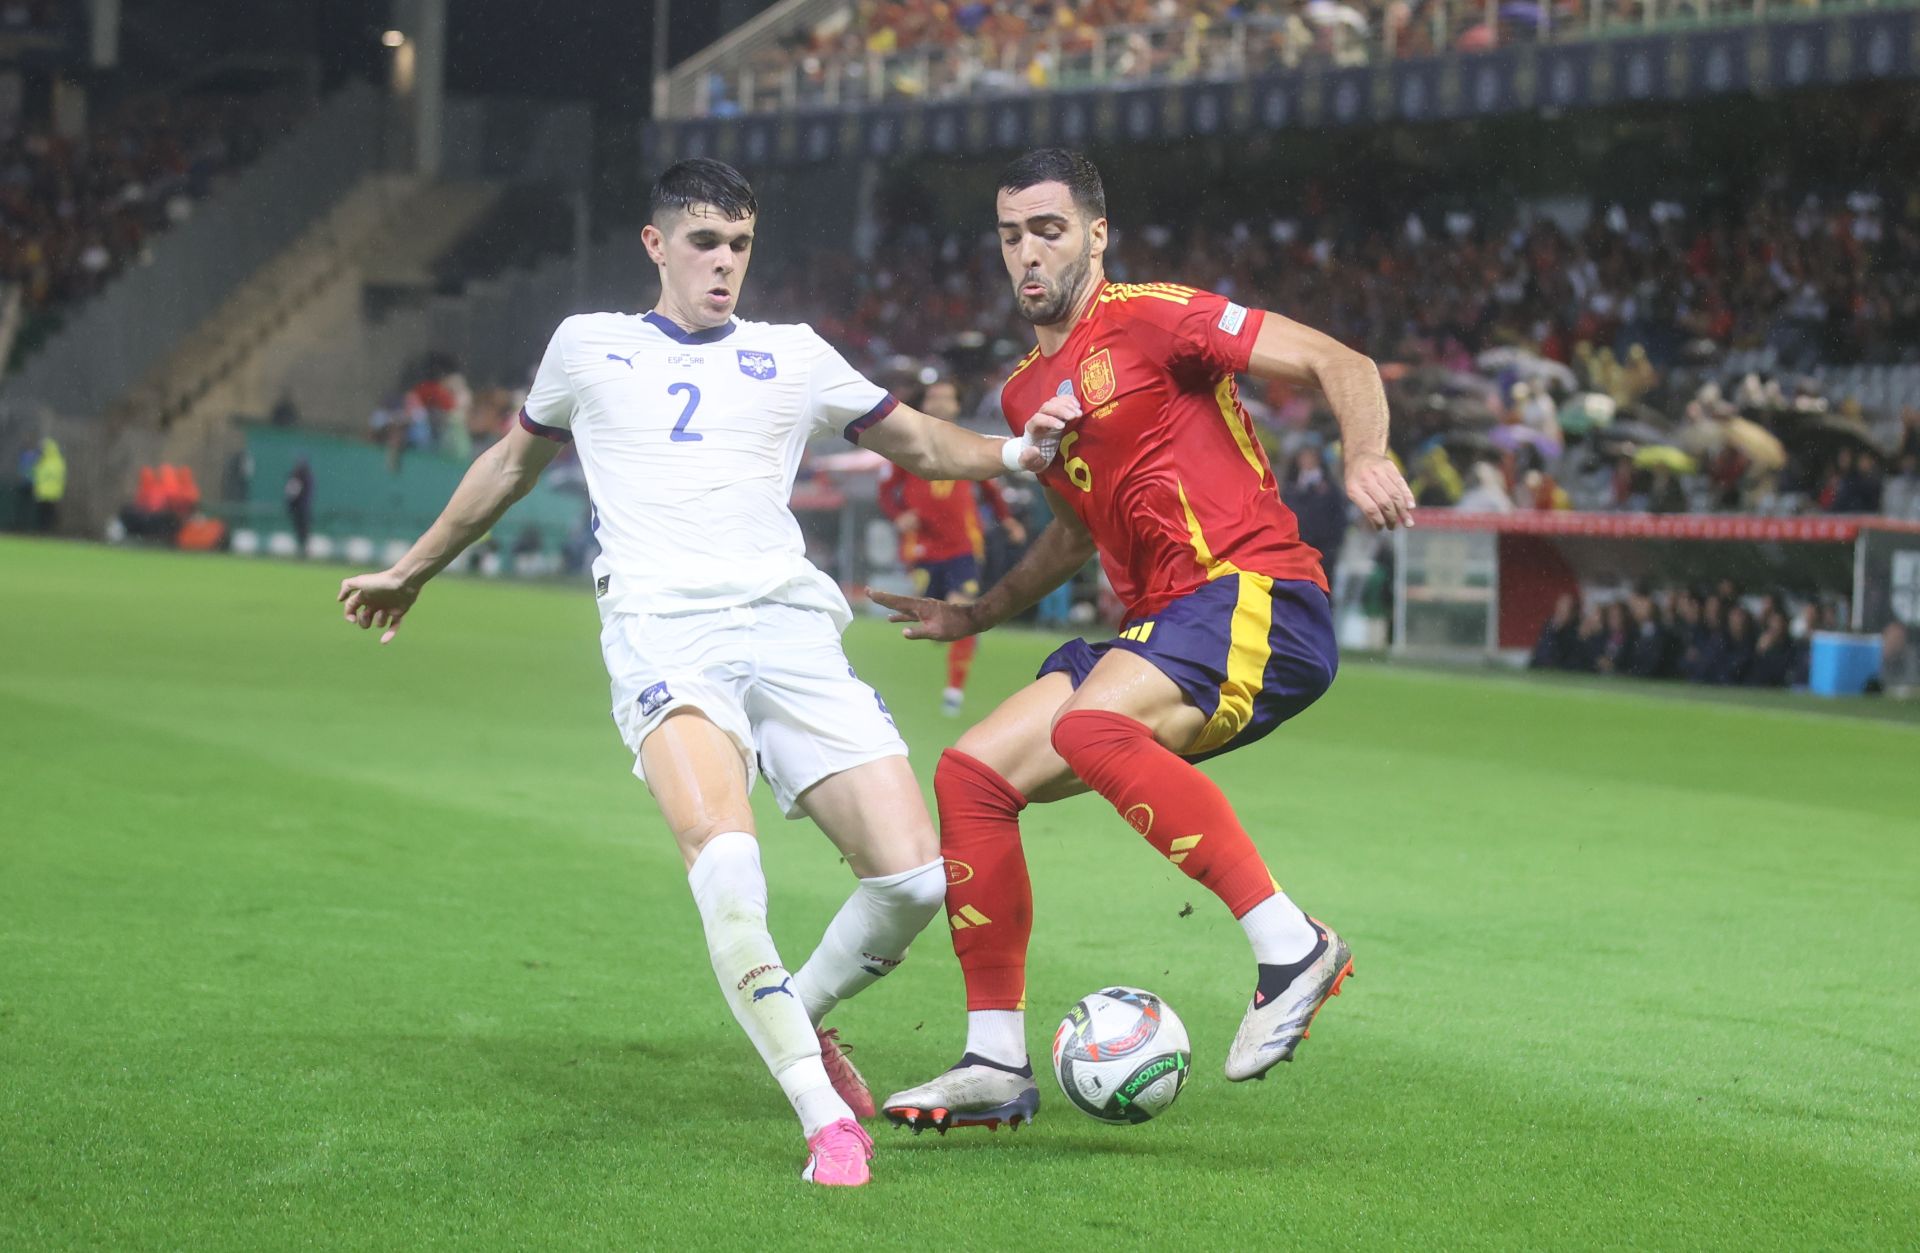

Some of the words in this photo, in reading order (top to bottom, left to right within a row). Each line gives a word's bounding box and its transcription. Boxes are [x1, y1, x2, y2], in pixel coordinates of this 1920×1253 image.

[667, 356, 683, 364] ESP
[689, 356, 705, 365] SRB
[667, 382, 703, 442] 2
[1060, 430, 1092, 492] 6
[1125, 1057, 1175, 1094] NATIONS
